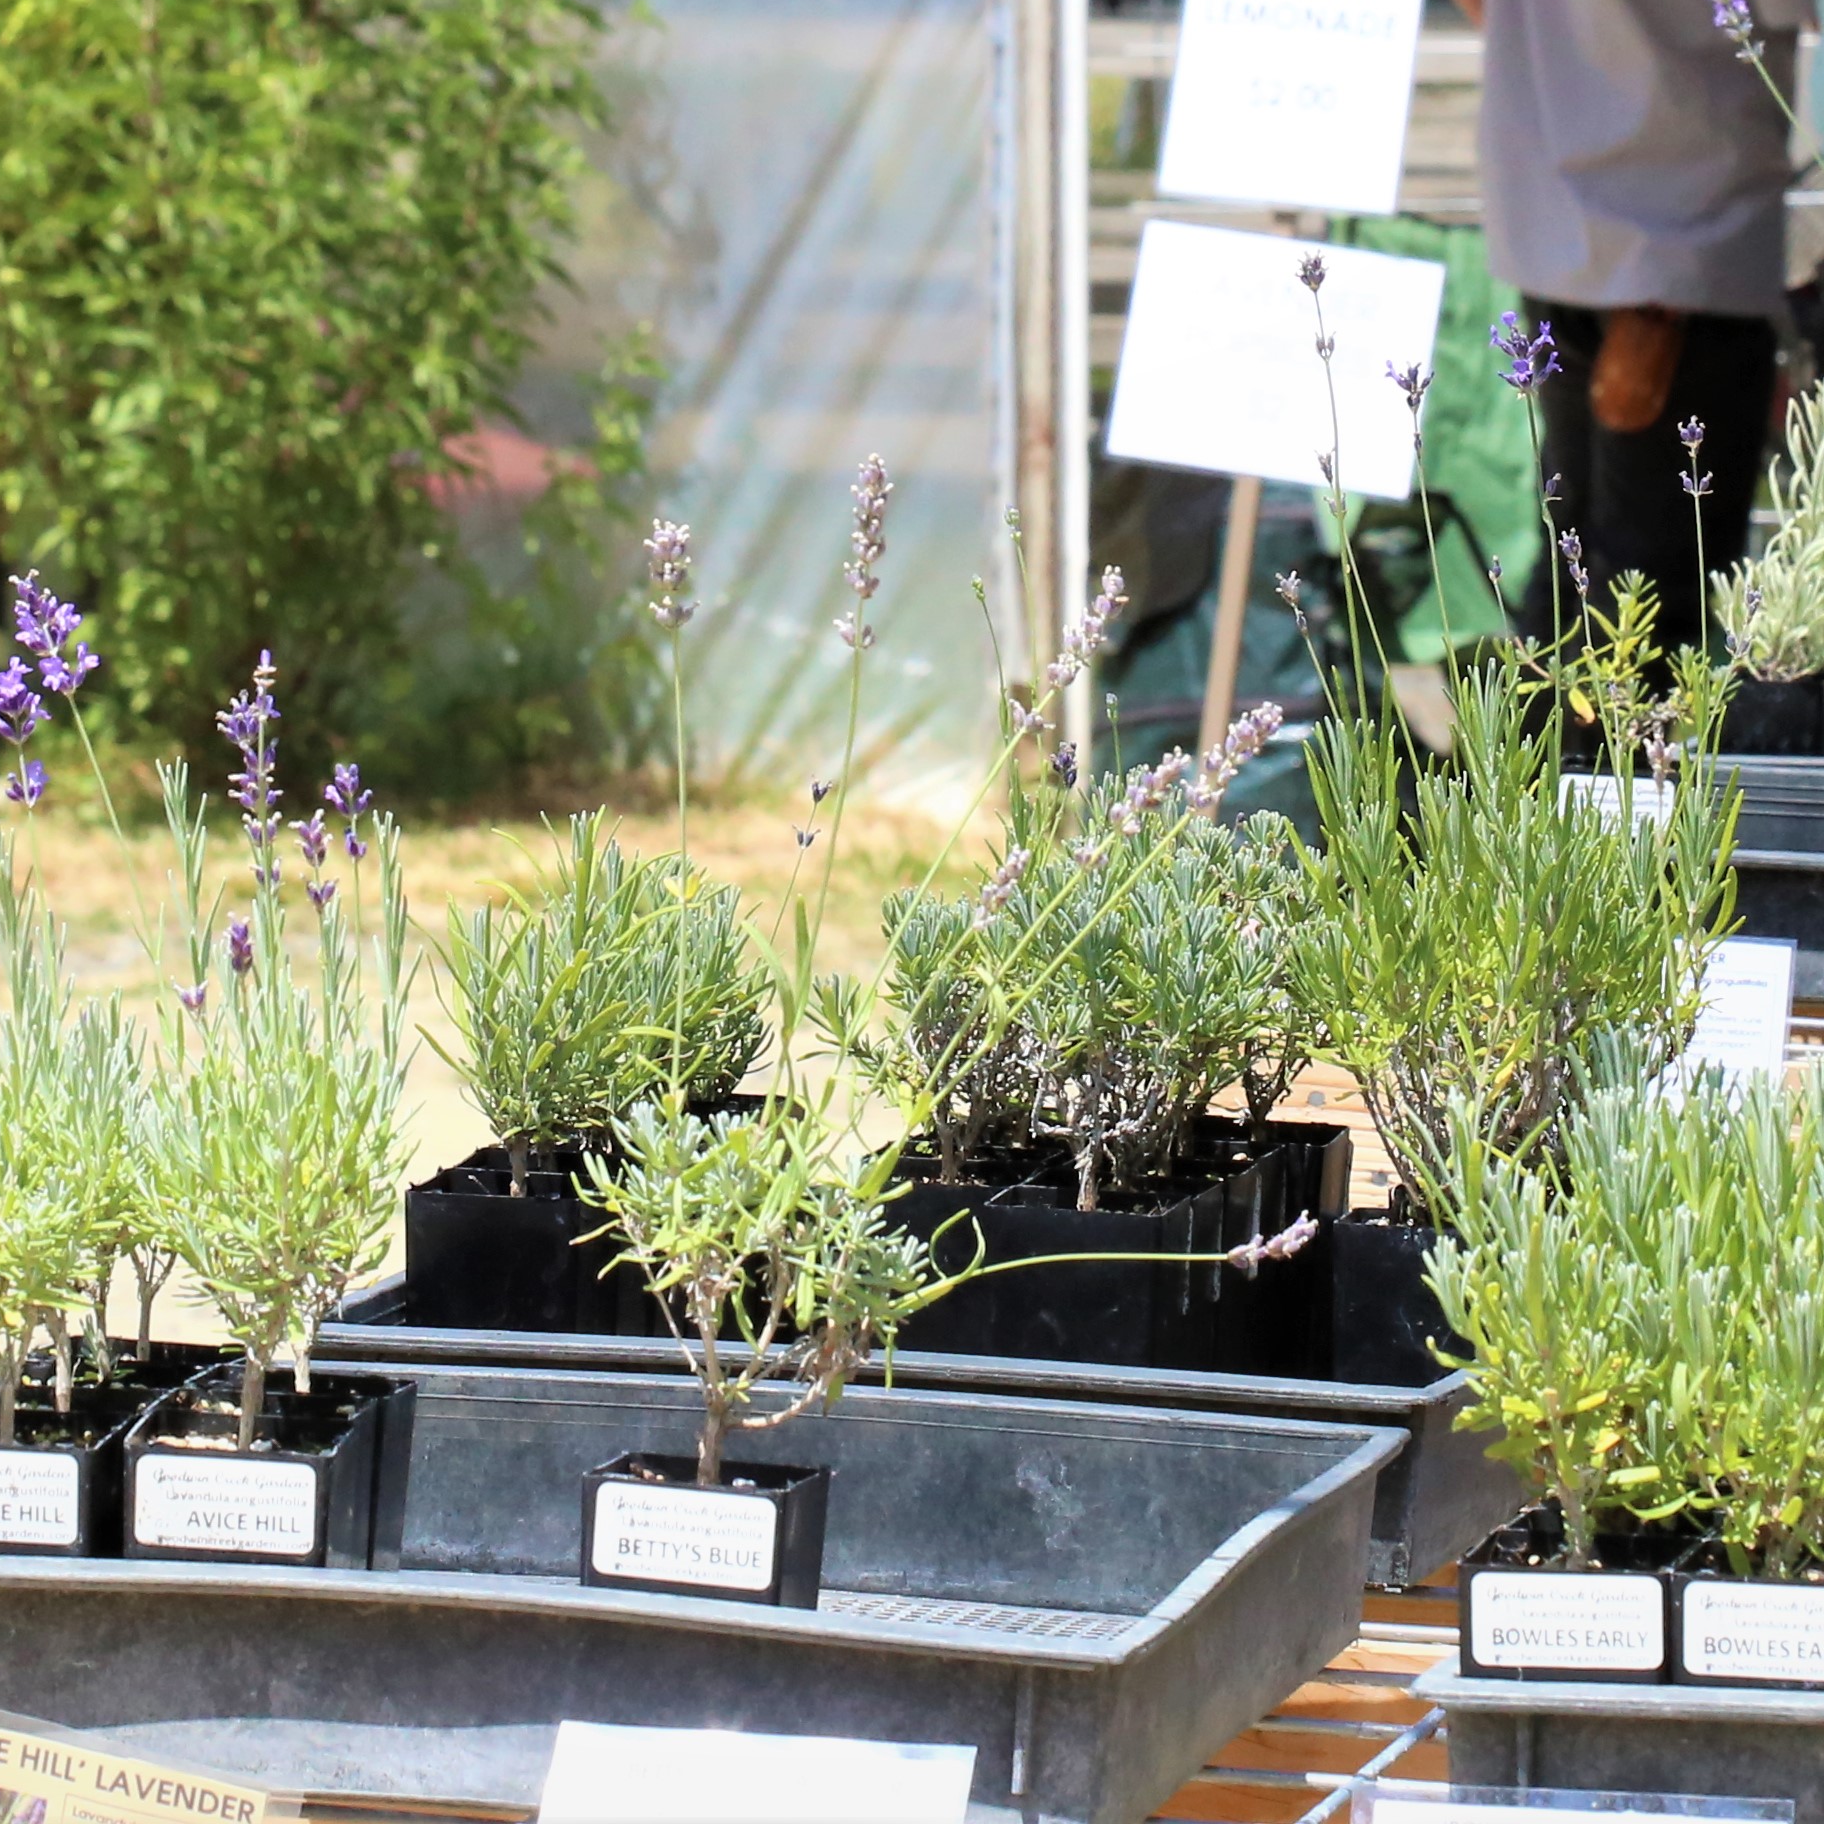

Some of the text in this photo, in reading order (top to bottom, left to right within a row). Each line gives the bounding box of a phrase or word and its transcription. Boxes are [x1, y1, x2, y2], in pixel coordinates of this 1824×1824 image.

[1249, 75, 1339, 113] $200
[18, 1464, 71, 1480] Gardens
[166, 1489, 308, 1507] Lavandula angustifolia
[19, 1505, 65, 1524] HILL
[187, 1510, 301, 1534] AVICE HILL
[617, 1537, 762, 1569] BETTY'S BLUE
[1492, 1627, 1649, 1648] BOWLES EARLY
[1704, 1636, 1791, 1658] BOWLES
[19, 1743, 86, 1783] HILL'
[94, 1764, 256, 1824] LAVENDER
